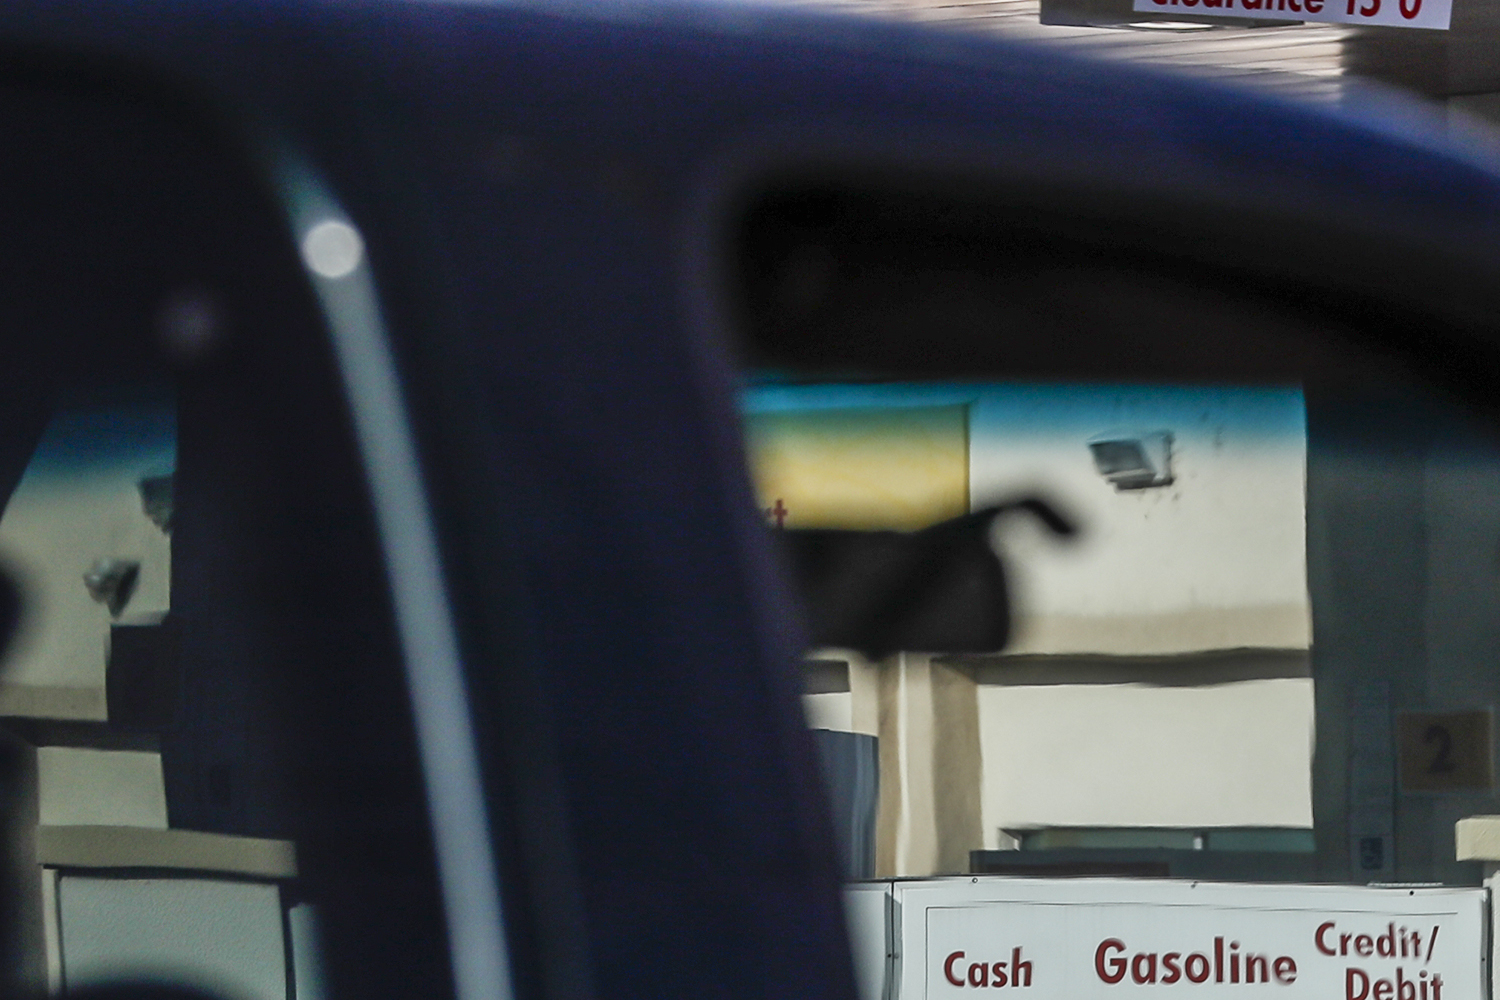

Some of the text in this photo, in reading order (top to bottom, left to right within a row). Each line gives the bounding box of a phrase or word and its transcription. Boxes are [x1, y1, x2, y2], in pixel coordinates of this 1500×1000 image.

[1426, 725, 1458, 773] 2
[944, 936, 1298, 988] Cash Gasoline
[1315, 920, 1440, 963] Credit/
